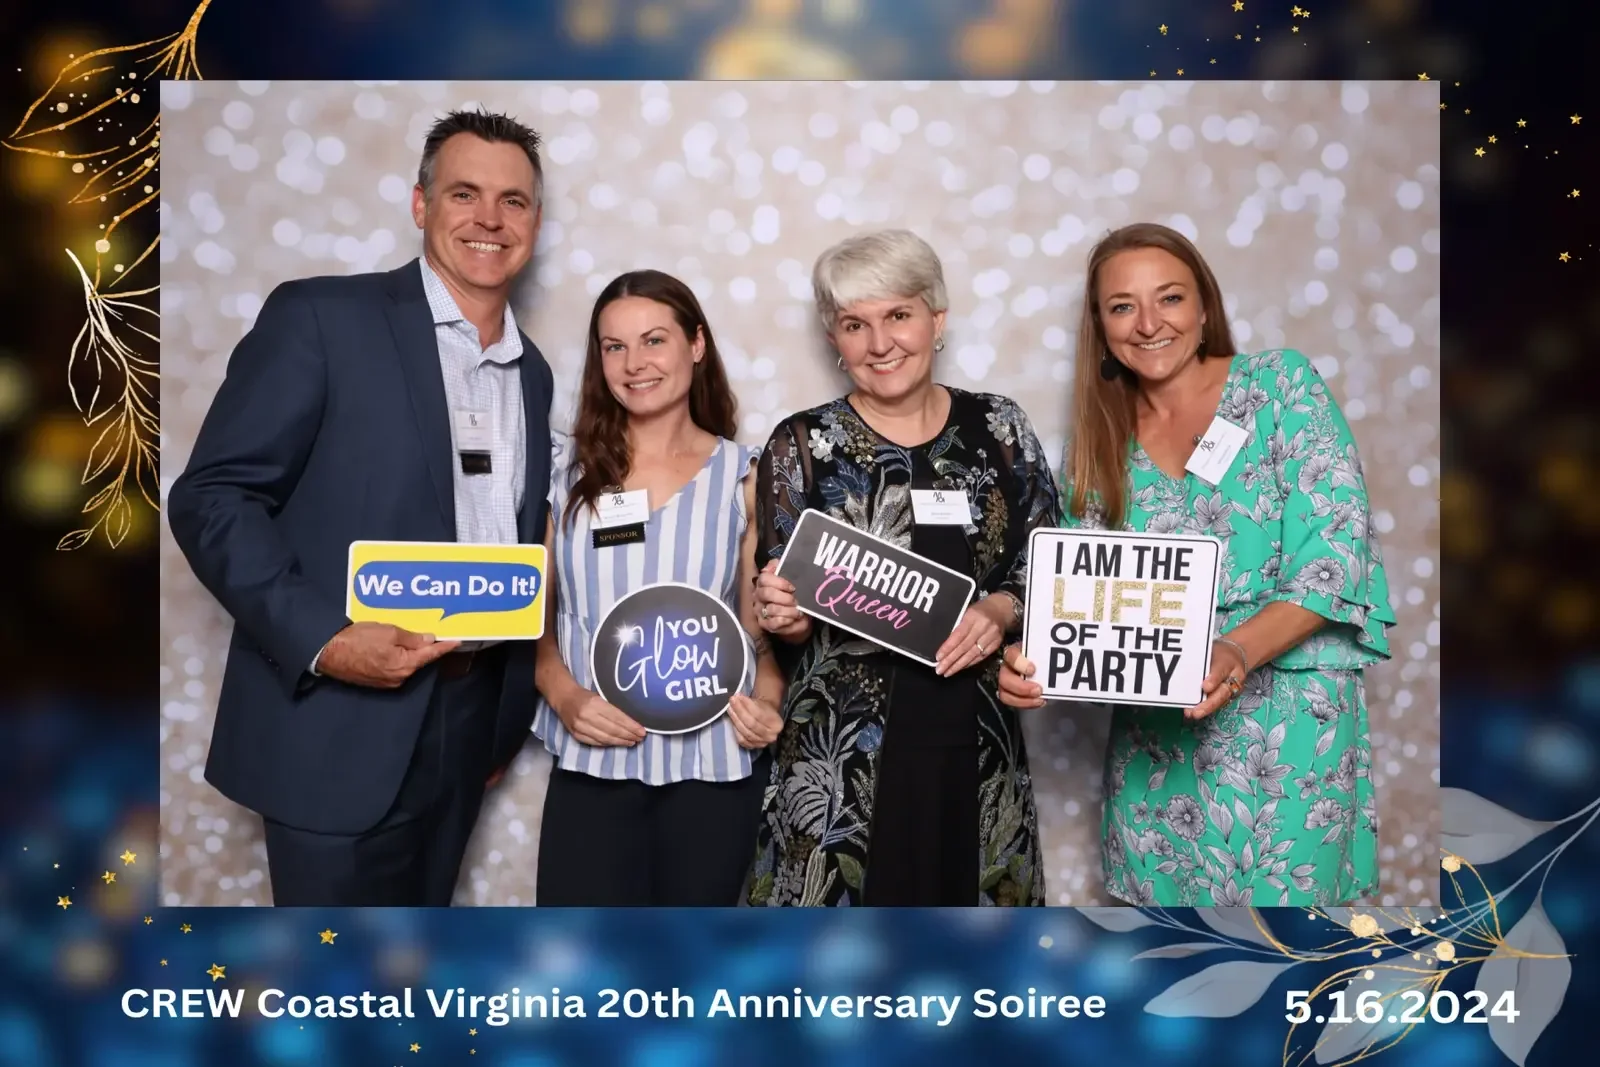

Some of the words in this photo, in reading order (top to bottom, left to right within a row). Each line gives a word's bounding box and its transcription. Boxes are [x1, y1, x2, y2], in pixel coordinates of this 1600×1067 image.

[599, 531, 638, 542] SPONSOR
[813, 531, 940, 614] WARRIOR
[1055, 541, 1064, 575] I
[1073, 543, 1122, 578] AM
[1132, 546, 1194, 582] THE
[358, 574, 404, 596] We
[410, 574, 461, 596] Can
[468, 575, 505, 596] Do
[511, 575, 536, 597] It!
[815, 565, 912, 630] Queen
[1052, 577, 1187, 627] LIFE
[666, 615, 719, 639] YOU
[1050, 622, 1099, 646] OF
[1111, 626, 1183, 652] THE
[614, 615, 720, 698] Glow
[1047, 647, 1181, 696] PARTY
[665, 675, 728, 701] GIRL
